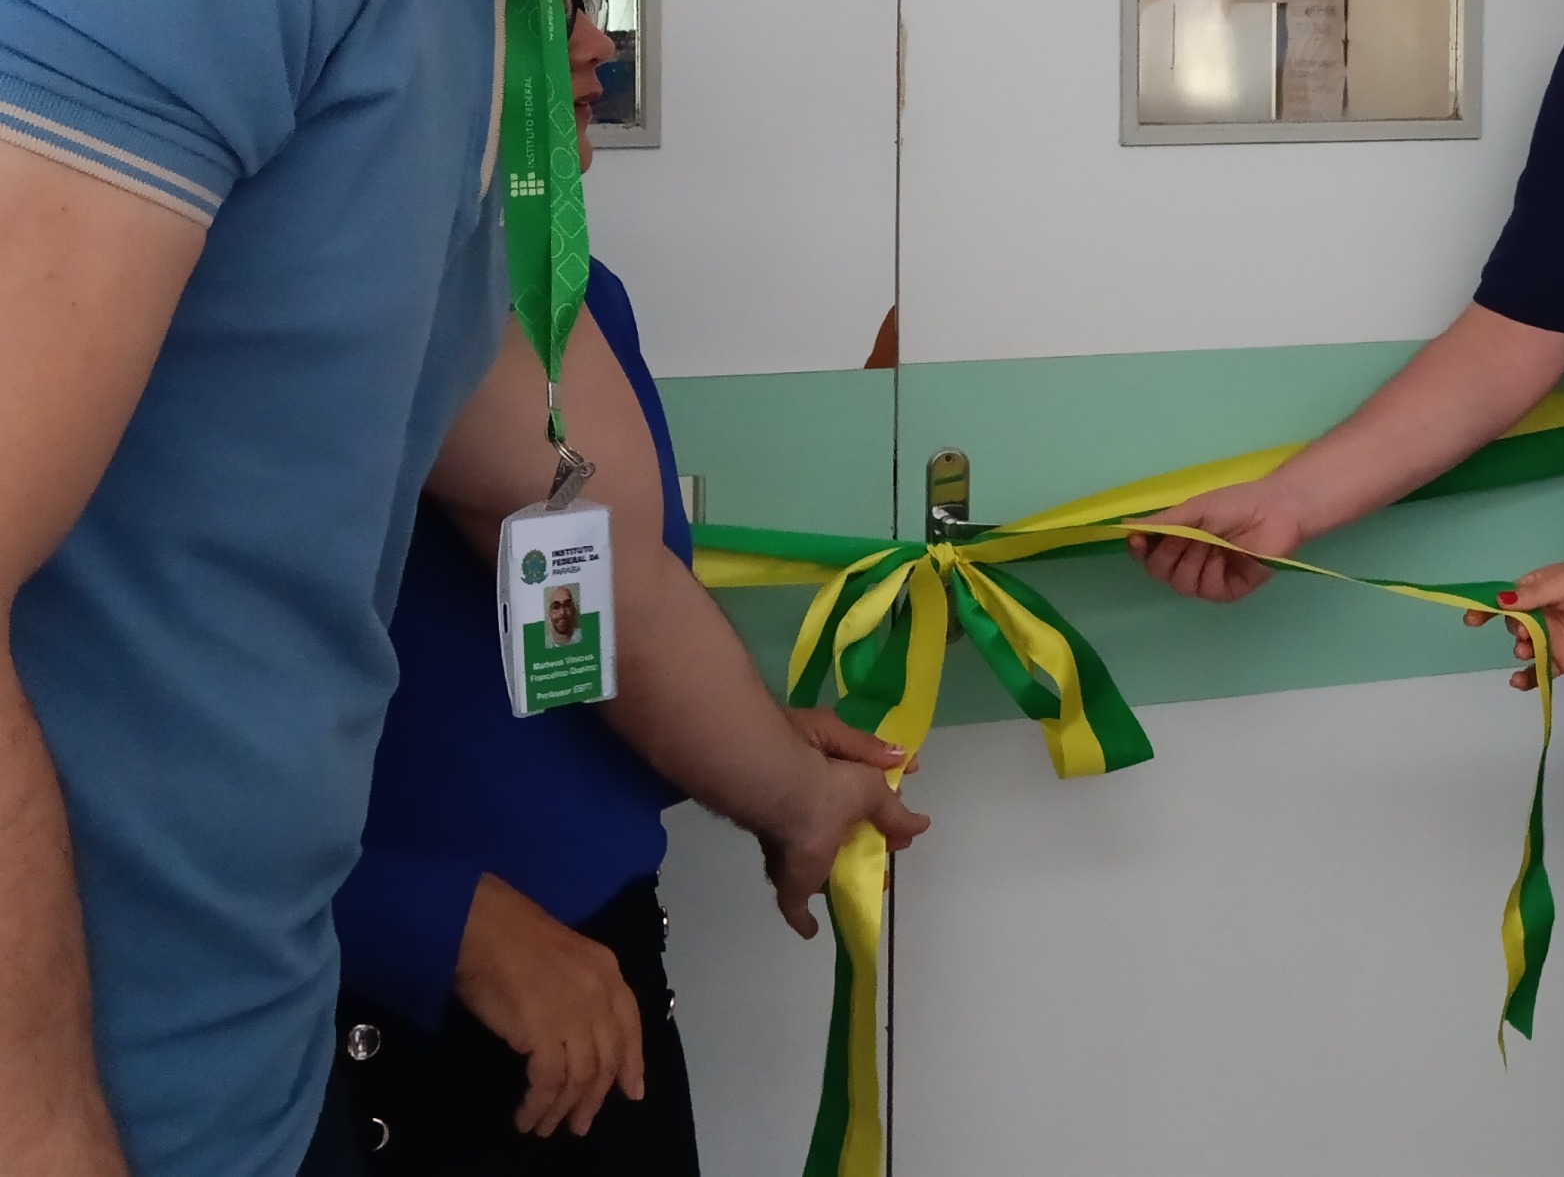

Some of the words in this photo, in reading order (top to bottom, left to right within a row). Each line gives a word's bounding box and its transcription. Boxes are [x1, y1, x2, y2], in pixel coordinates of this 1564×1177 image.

[523, 76, 534, 117] FEDERAL
[552, 545, 594, 558] INSTITUTO
[552, 555, 588, 566] FEDERAL
